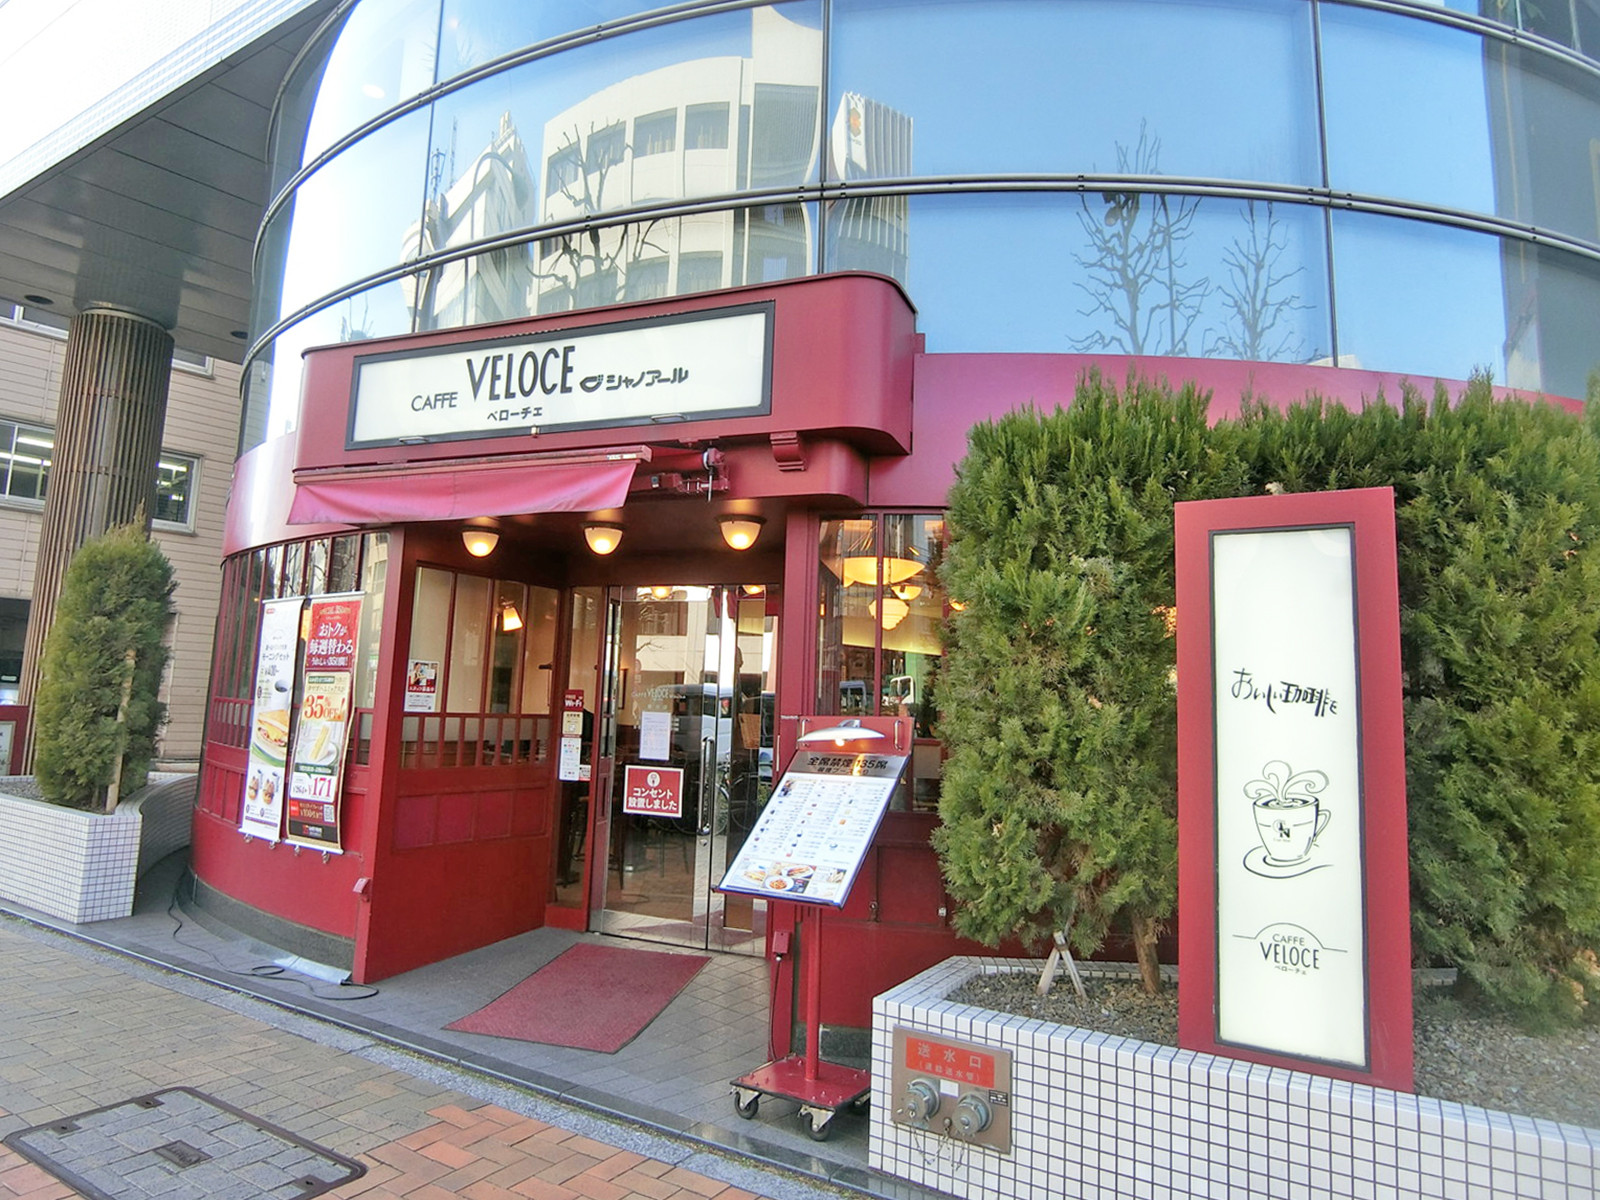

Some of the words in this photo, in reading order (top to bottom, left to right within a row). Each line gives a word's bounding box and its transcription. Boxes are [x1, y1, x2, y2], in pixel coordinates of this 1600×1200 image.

[411, 391, 458, 412] CAFFE
[466, 345, 576, 402] VELOCE
[605, 367, 689, 391] シャノアール
[807, 757, 852, 768] 全席禁煙
[633, 787, 673, 799] コンセント
[628, 797, 677, 810] 設置しました
[1272, 933, 1305, 947] CAFFE
[1260, 941, 1319, 970] VELOCE
